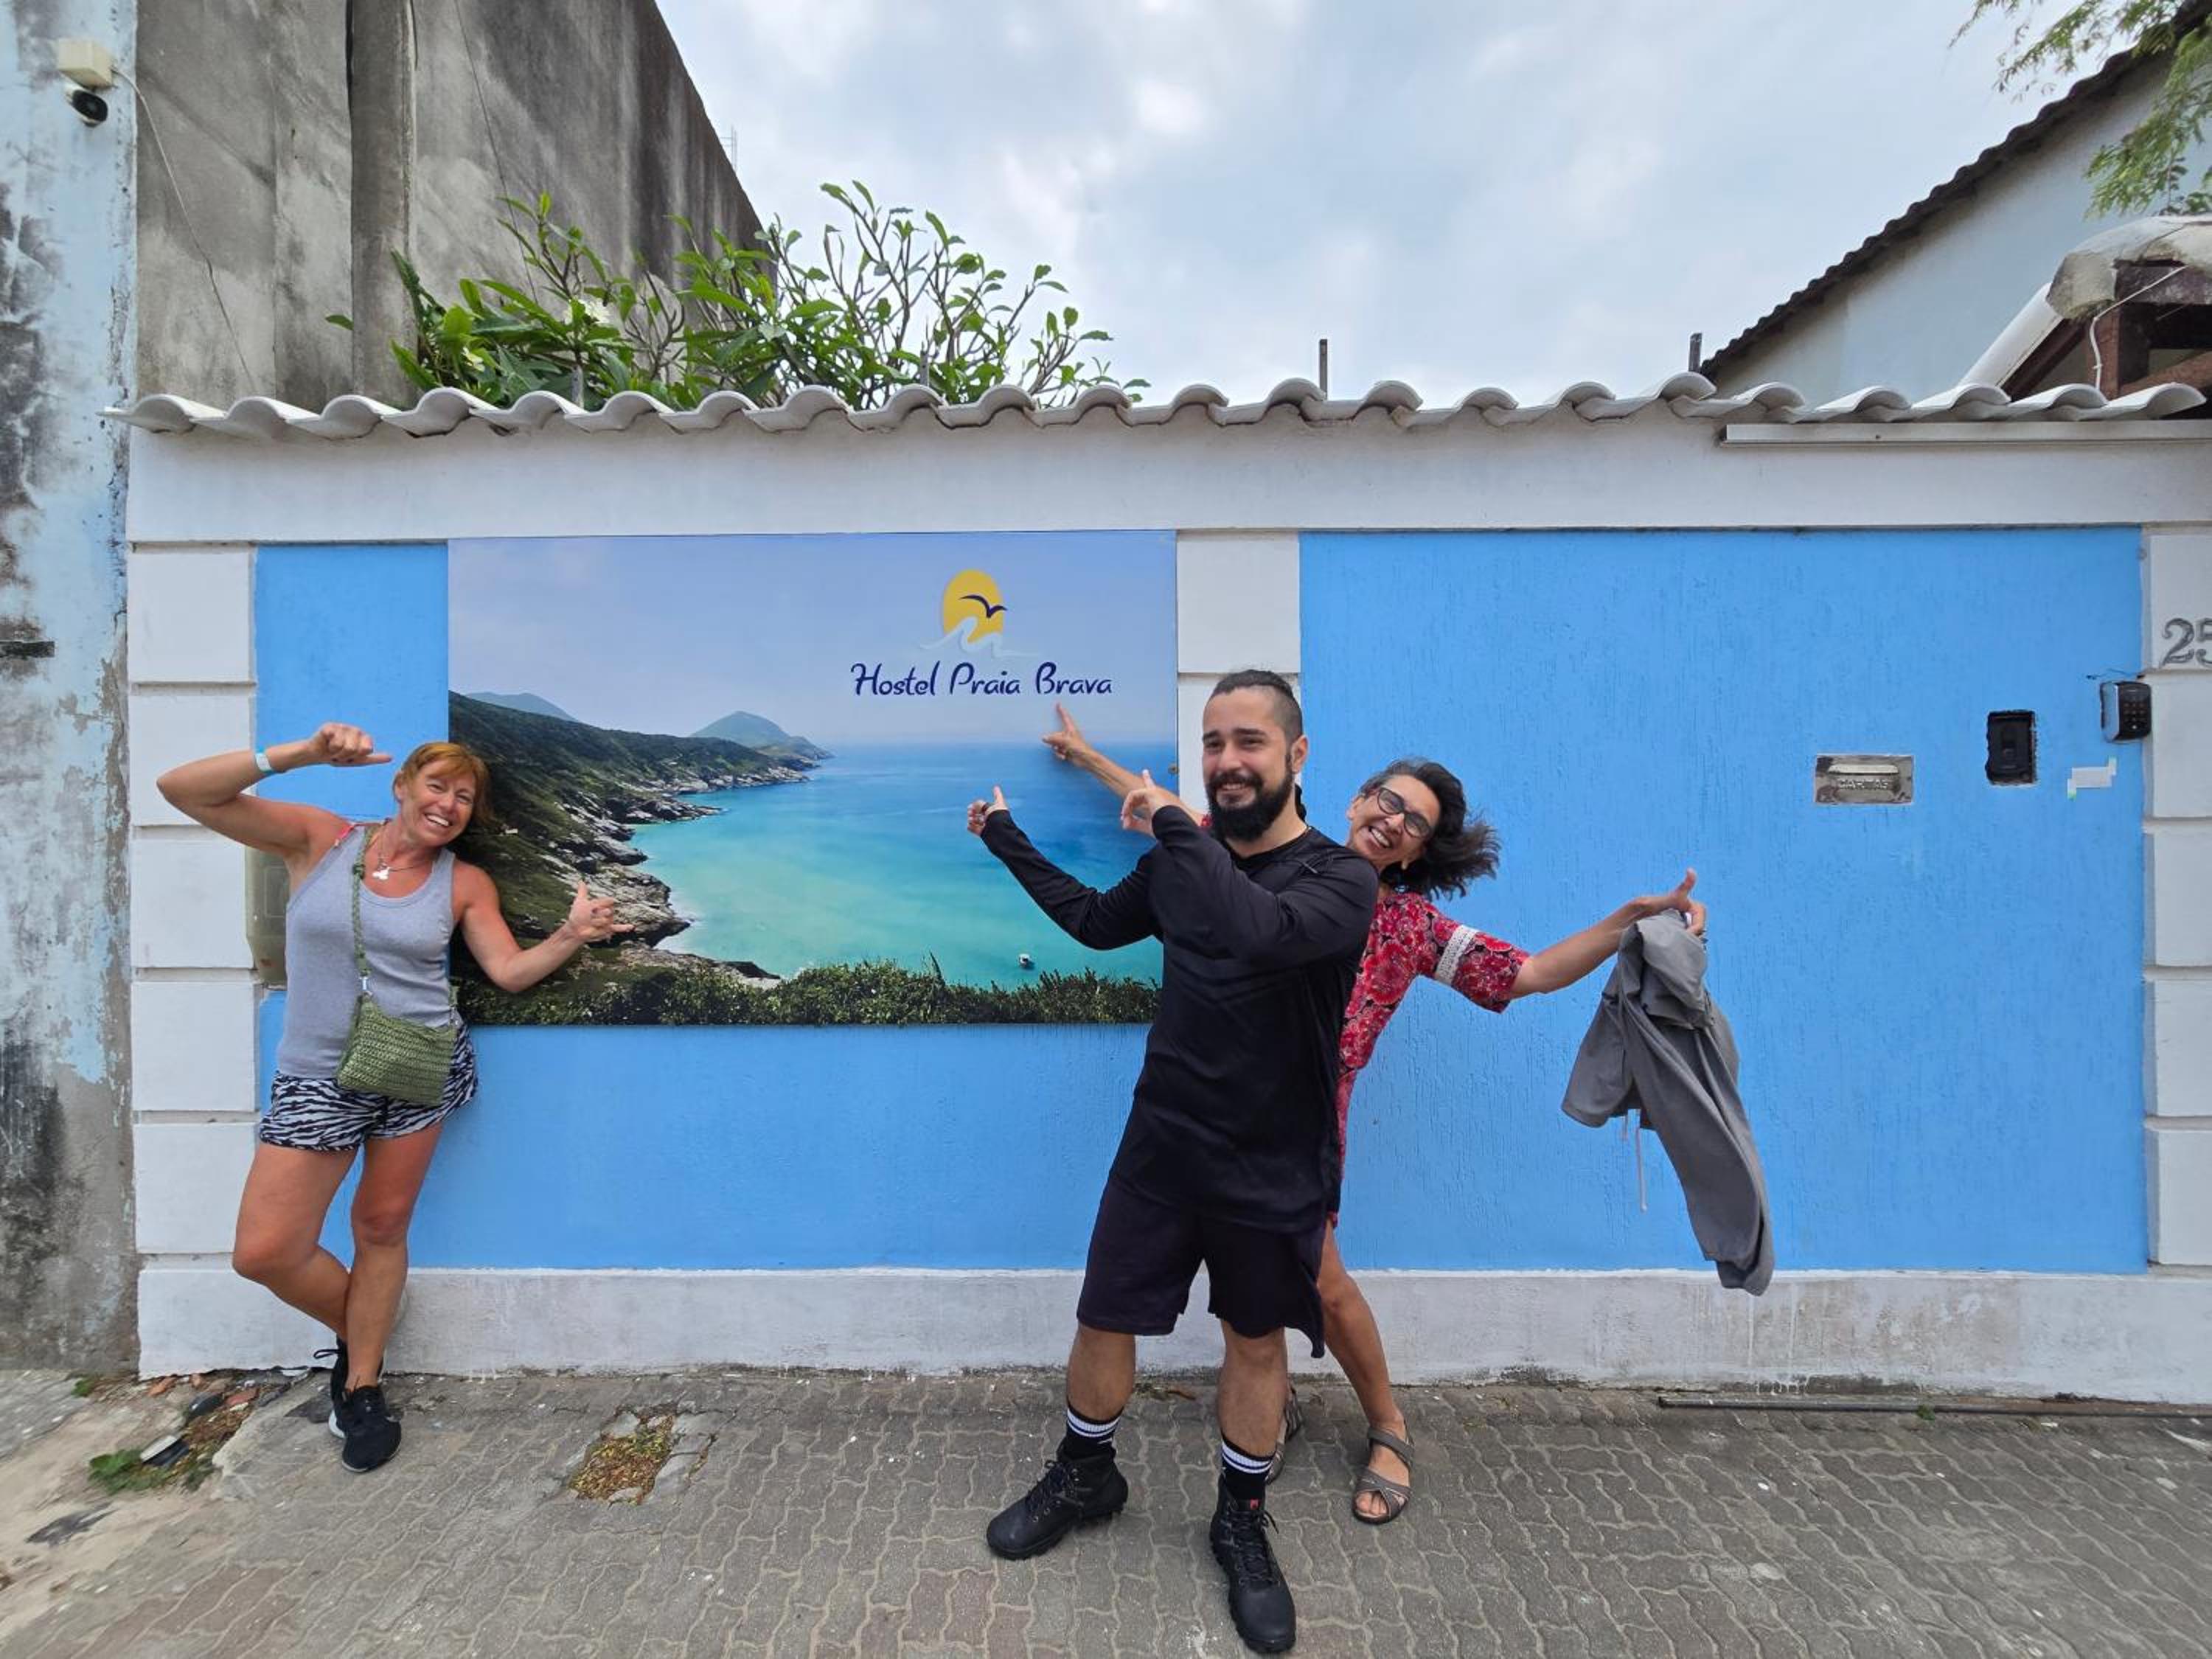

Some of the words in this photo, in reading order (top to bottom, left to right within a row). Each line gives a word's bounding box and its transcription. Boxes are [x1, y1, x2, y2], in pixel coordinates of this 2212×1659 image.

[850, 660, 941, 696] Hostel
[949, 661, 1021, 695] Praia
[1035, 661, 1113, 695] Brava
